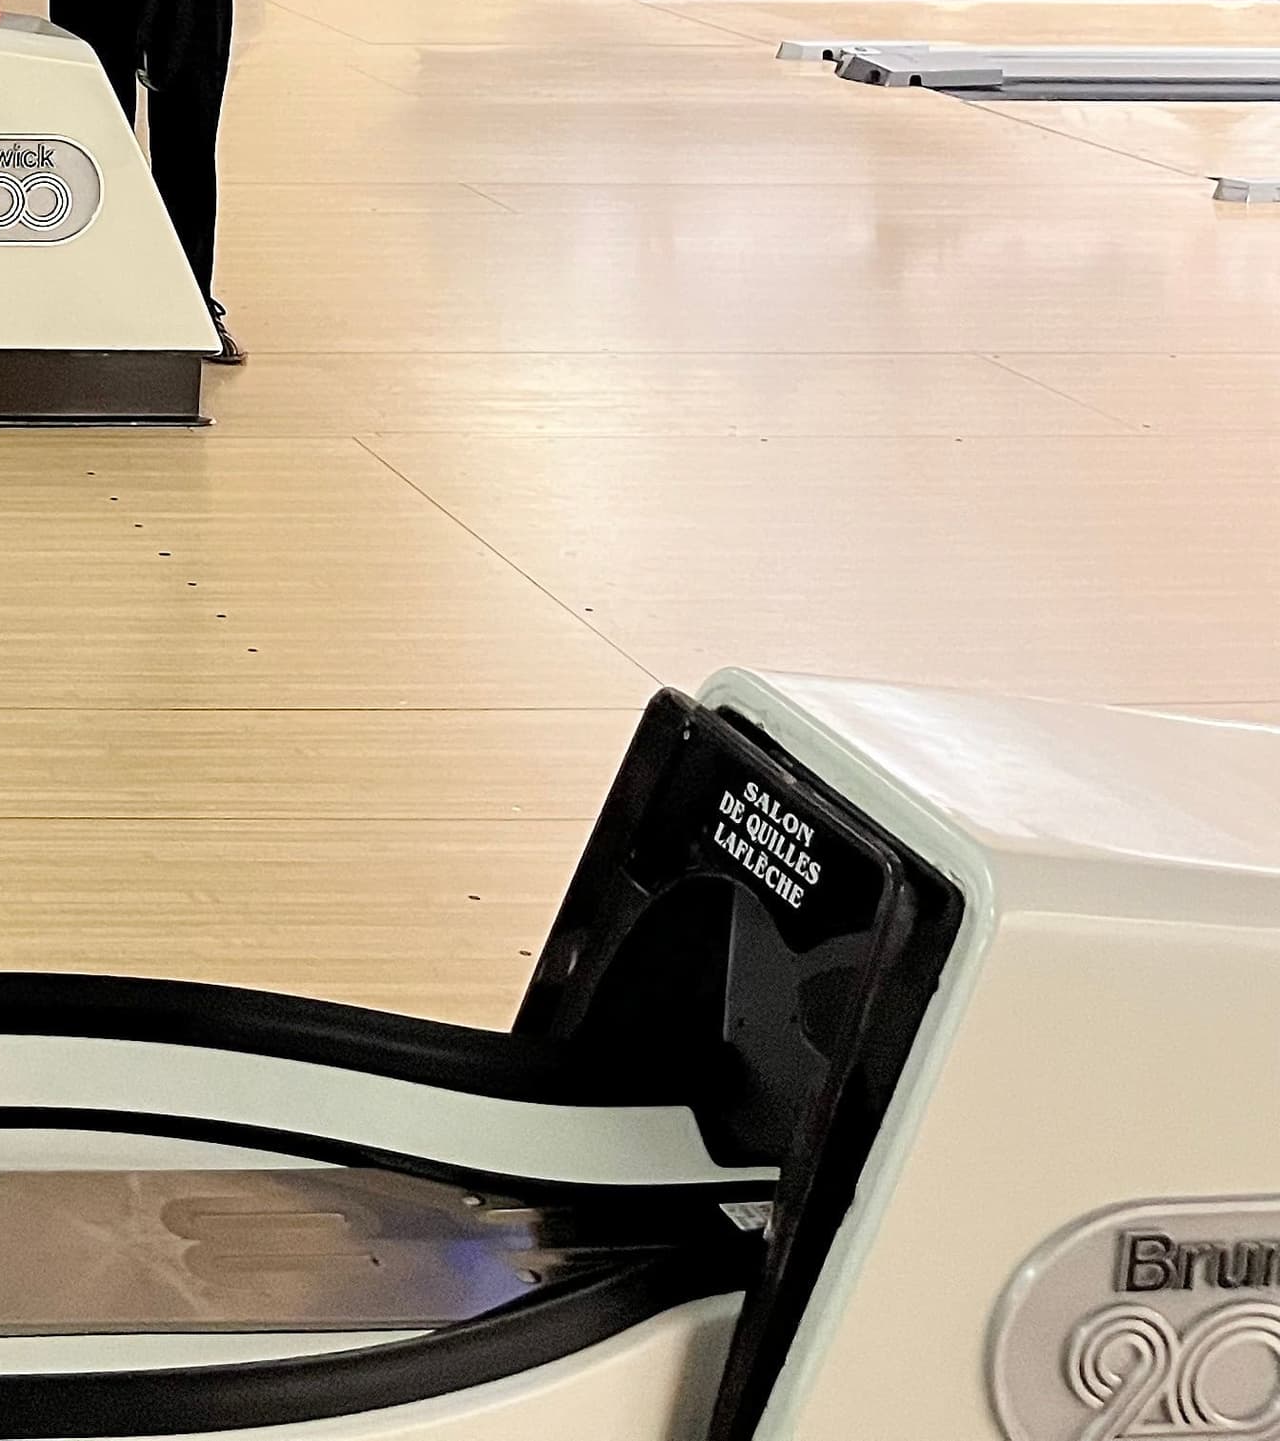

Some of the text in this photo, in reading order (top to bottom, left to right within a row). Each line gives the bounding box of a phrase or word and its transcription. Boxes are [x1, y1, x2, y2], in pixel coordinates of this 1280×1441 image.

[719, 790, 822, 885] DE QUILLES
[743, 782, 815, 848] SALON
[713, 821, 805, 909] LAFLÈCHE
